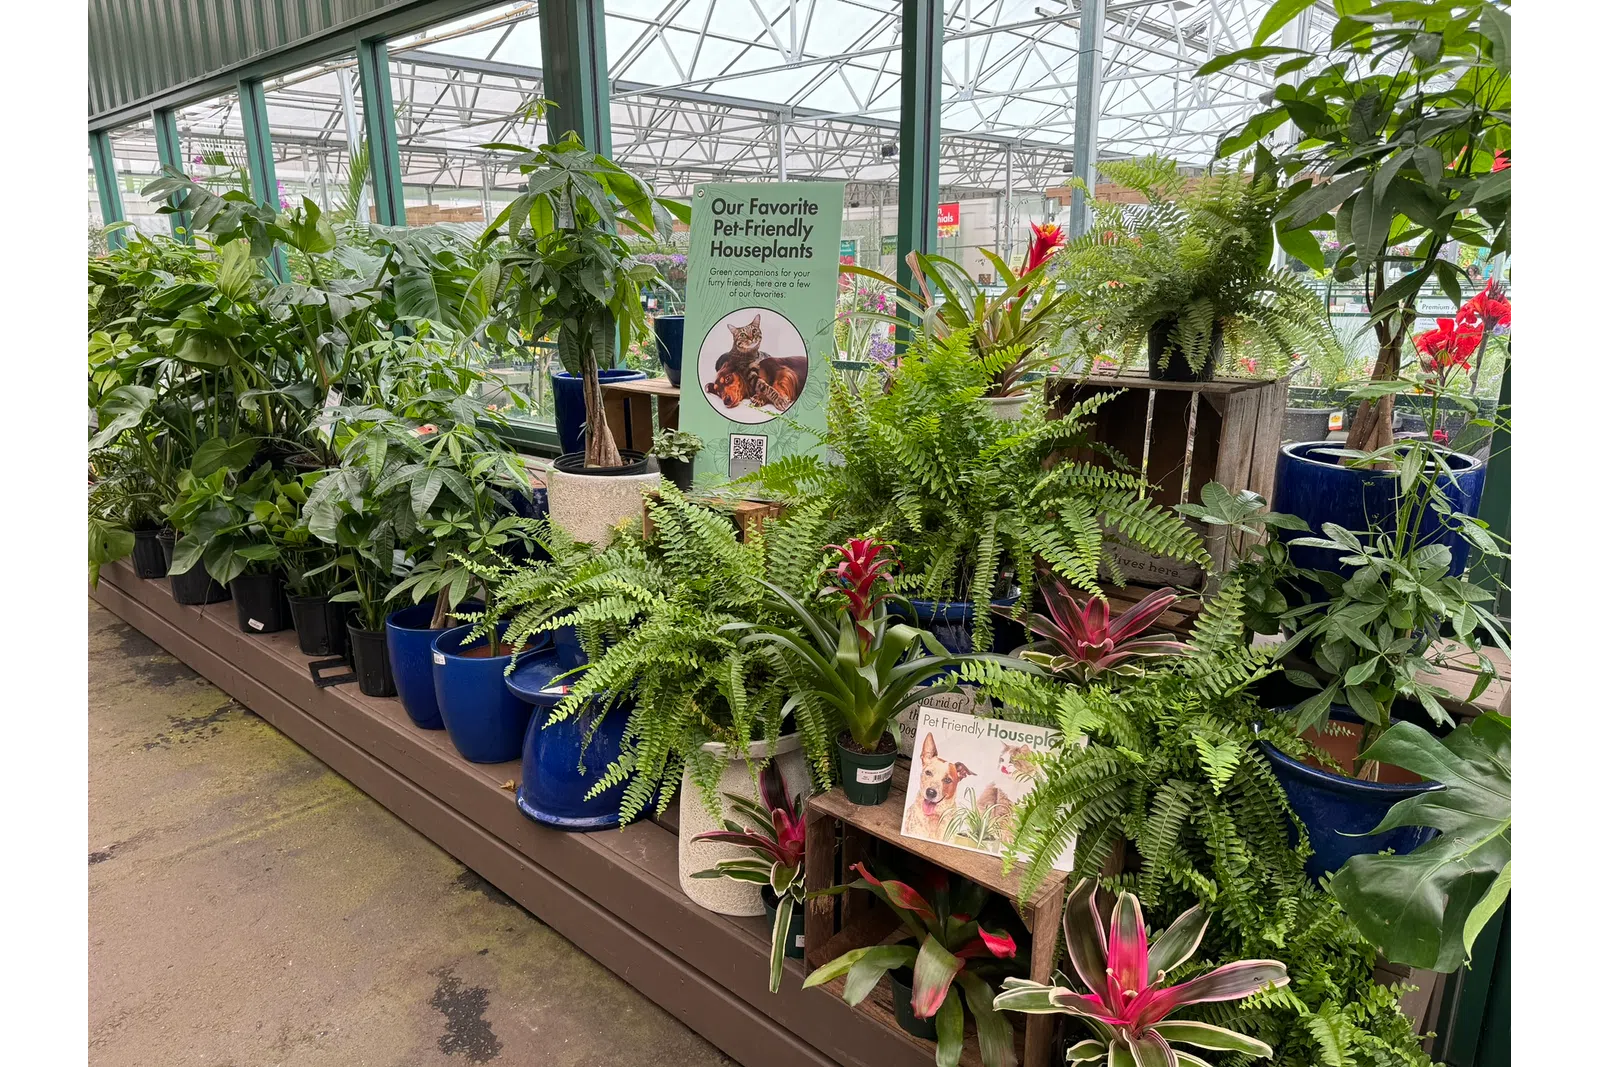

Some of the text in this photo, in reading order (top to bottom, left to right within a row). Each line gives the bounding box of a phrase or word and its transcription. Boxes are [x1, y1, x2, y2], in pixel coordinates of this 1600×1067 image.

[711, 197, 819, 215] Our Favorite
[713, 217, 814, 242] Pet-Friendly
[710, 239, 813, 263] Houseplants
[709, 268, 811, 279] Green companions for your
[708, 278, 725, 288] furry
[726, 278, 753, 288] friends,
[755, 279, 772, 287] here
[796, 279, 811, 288] few
[729, 288, 786, 299] of our favorites.
[1114, 553, 1145, 570] lives
[1149, 561, 1181, 578] here.
[936, 696, 950, 709] rid
[923, 713, 1080, 750] Pet Friendly Housepla
